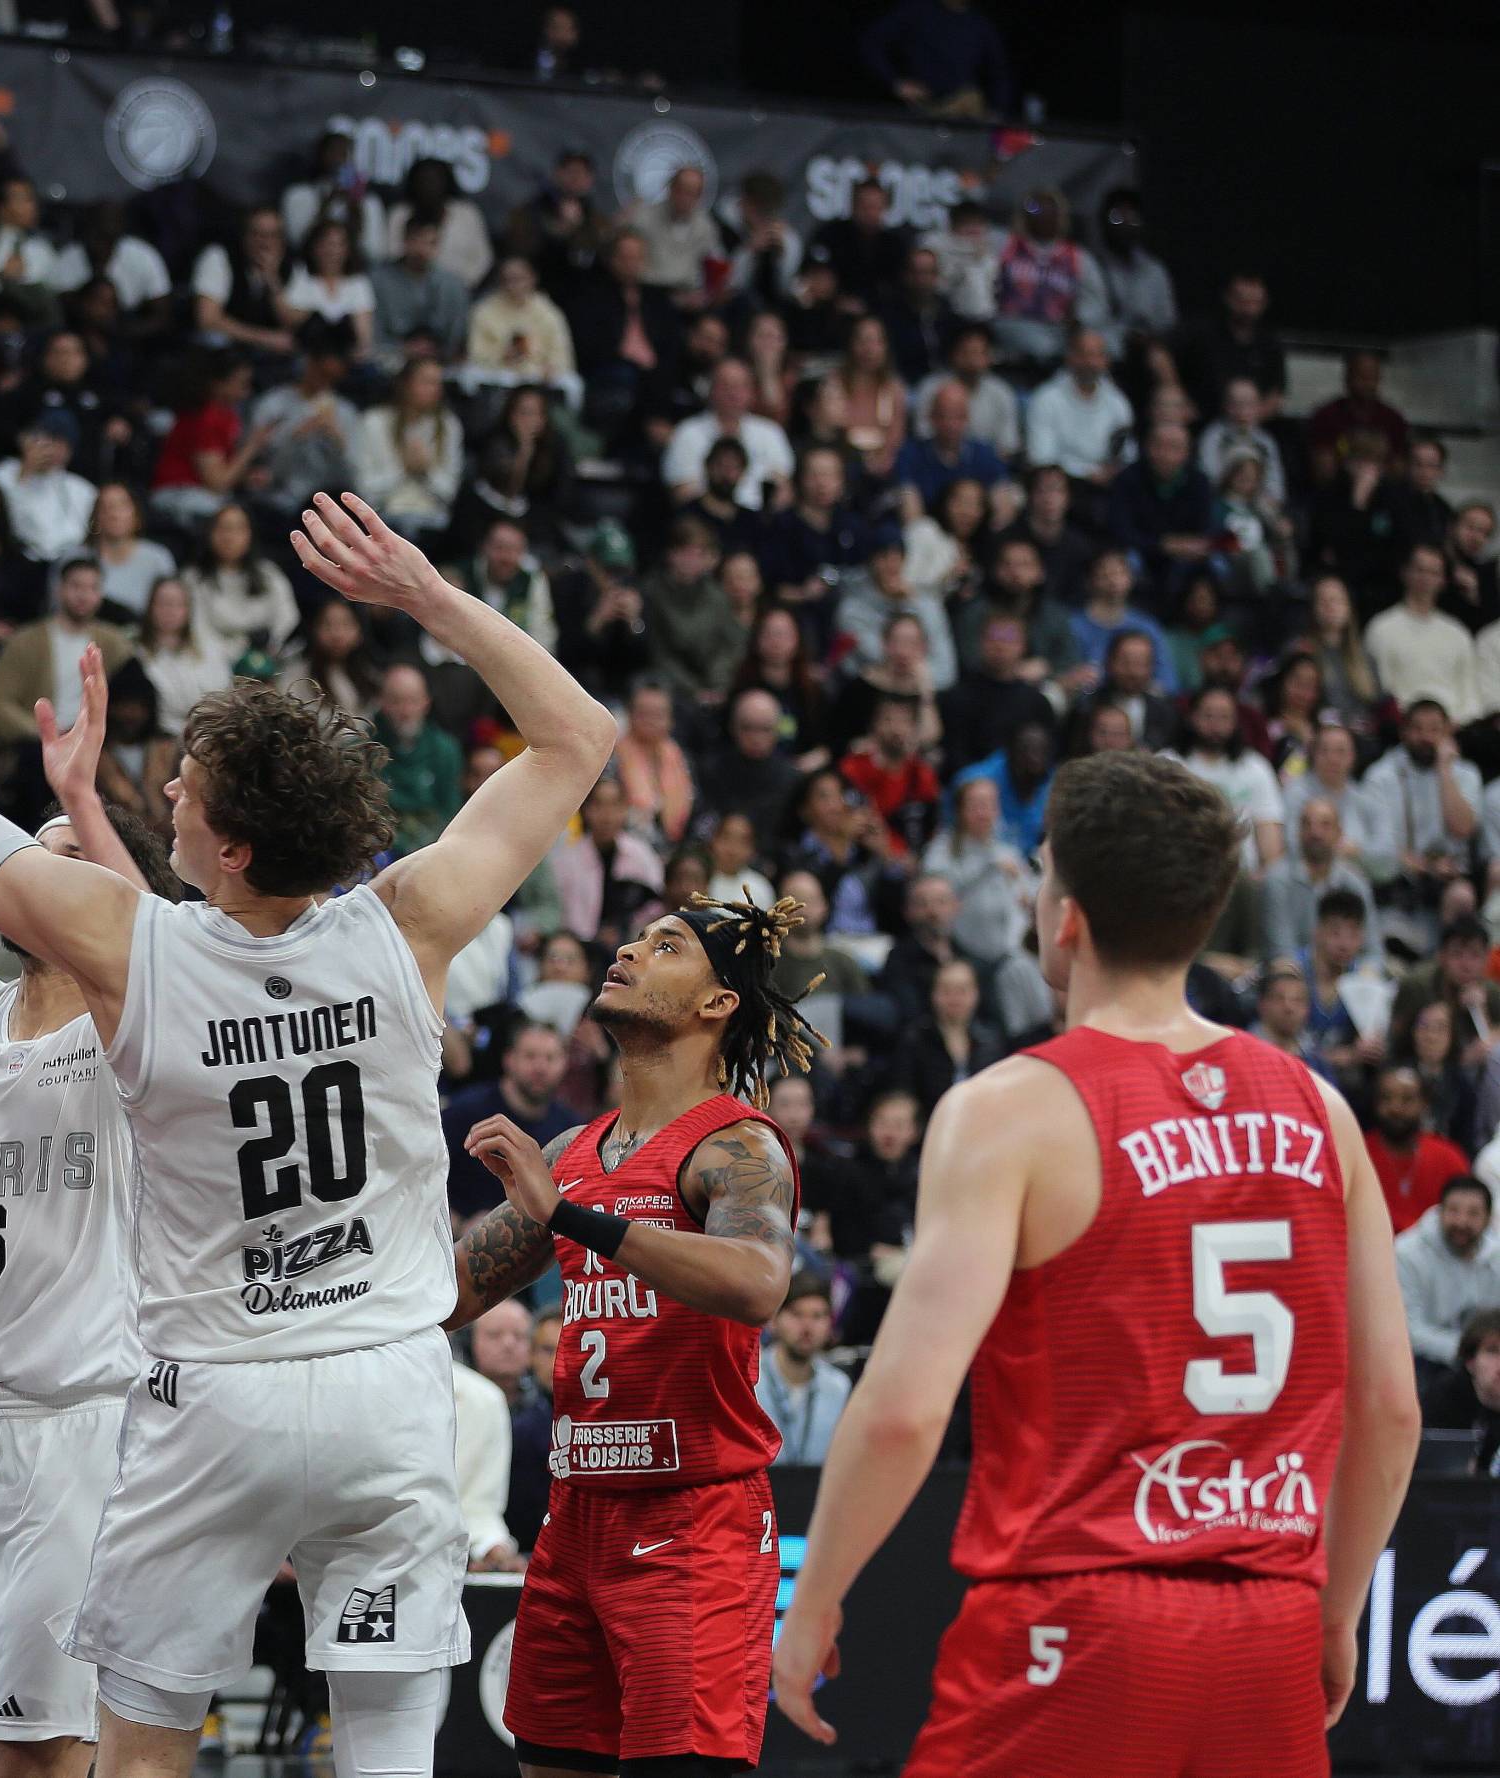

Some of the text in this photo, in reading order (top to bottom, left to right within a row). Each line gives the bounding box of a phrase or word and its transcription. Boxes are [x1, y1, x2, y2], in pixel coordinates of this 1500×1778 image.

[201, 995, 377, 1068] JANTUNEN
[228, 1059, 368, 1222] 20
[1117, 1112, 1325, 1198] BENITEZ
[240, 1216, 374, 1283] PIZZA
[262, 1224, 285, 1242] La
[240, 1281, 373, 1315] Delamama
[562, 1273, 658, 1327] BOURG
[1182, 1219, 1295, 1416] 5
[147, 1359, 180, 1408] 20
[579, 1329, 610, 1399] 2
[579, 1444, 653, 1469] LOISIRS
[760, 1510, 774, 1555] 2
[1026, 1624, 1069, 1687] 5
